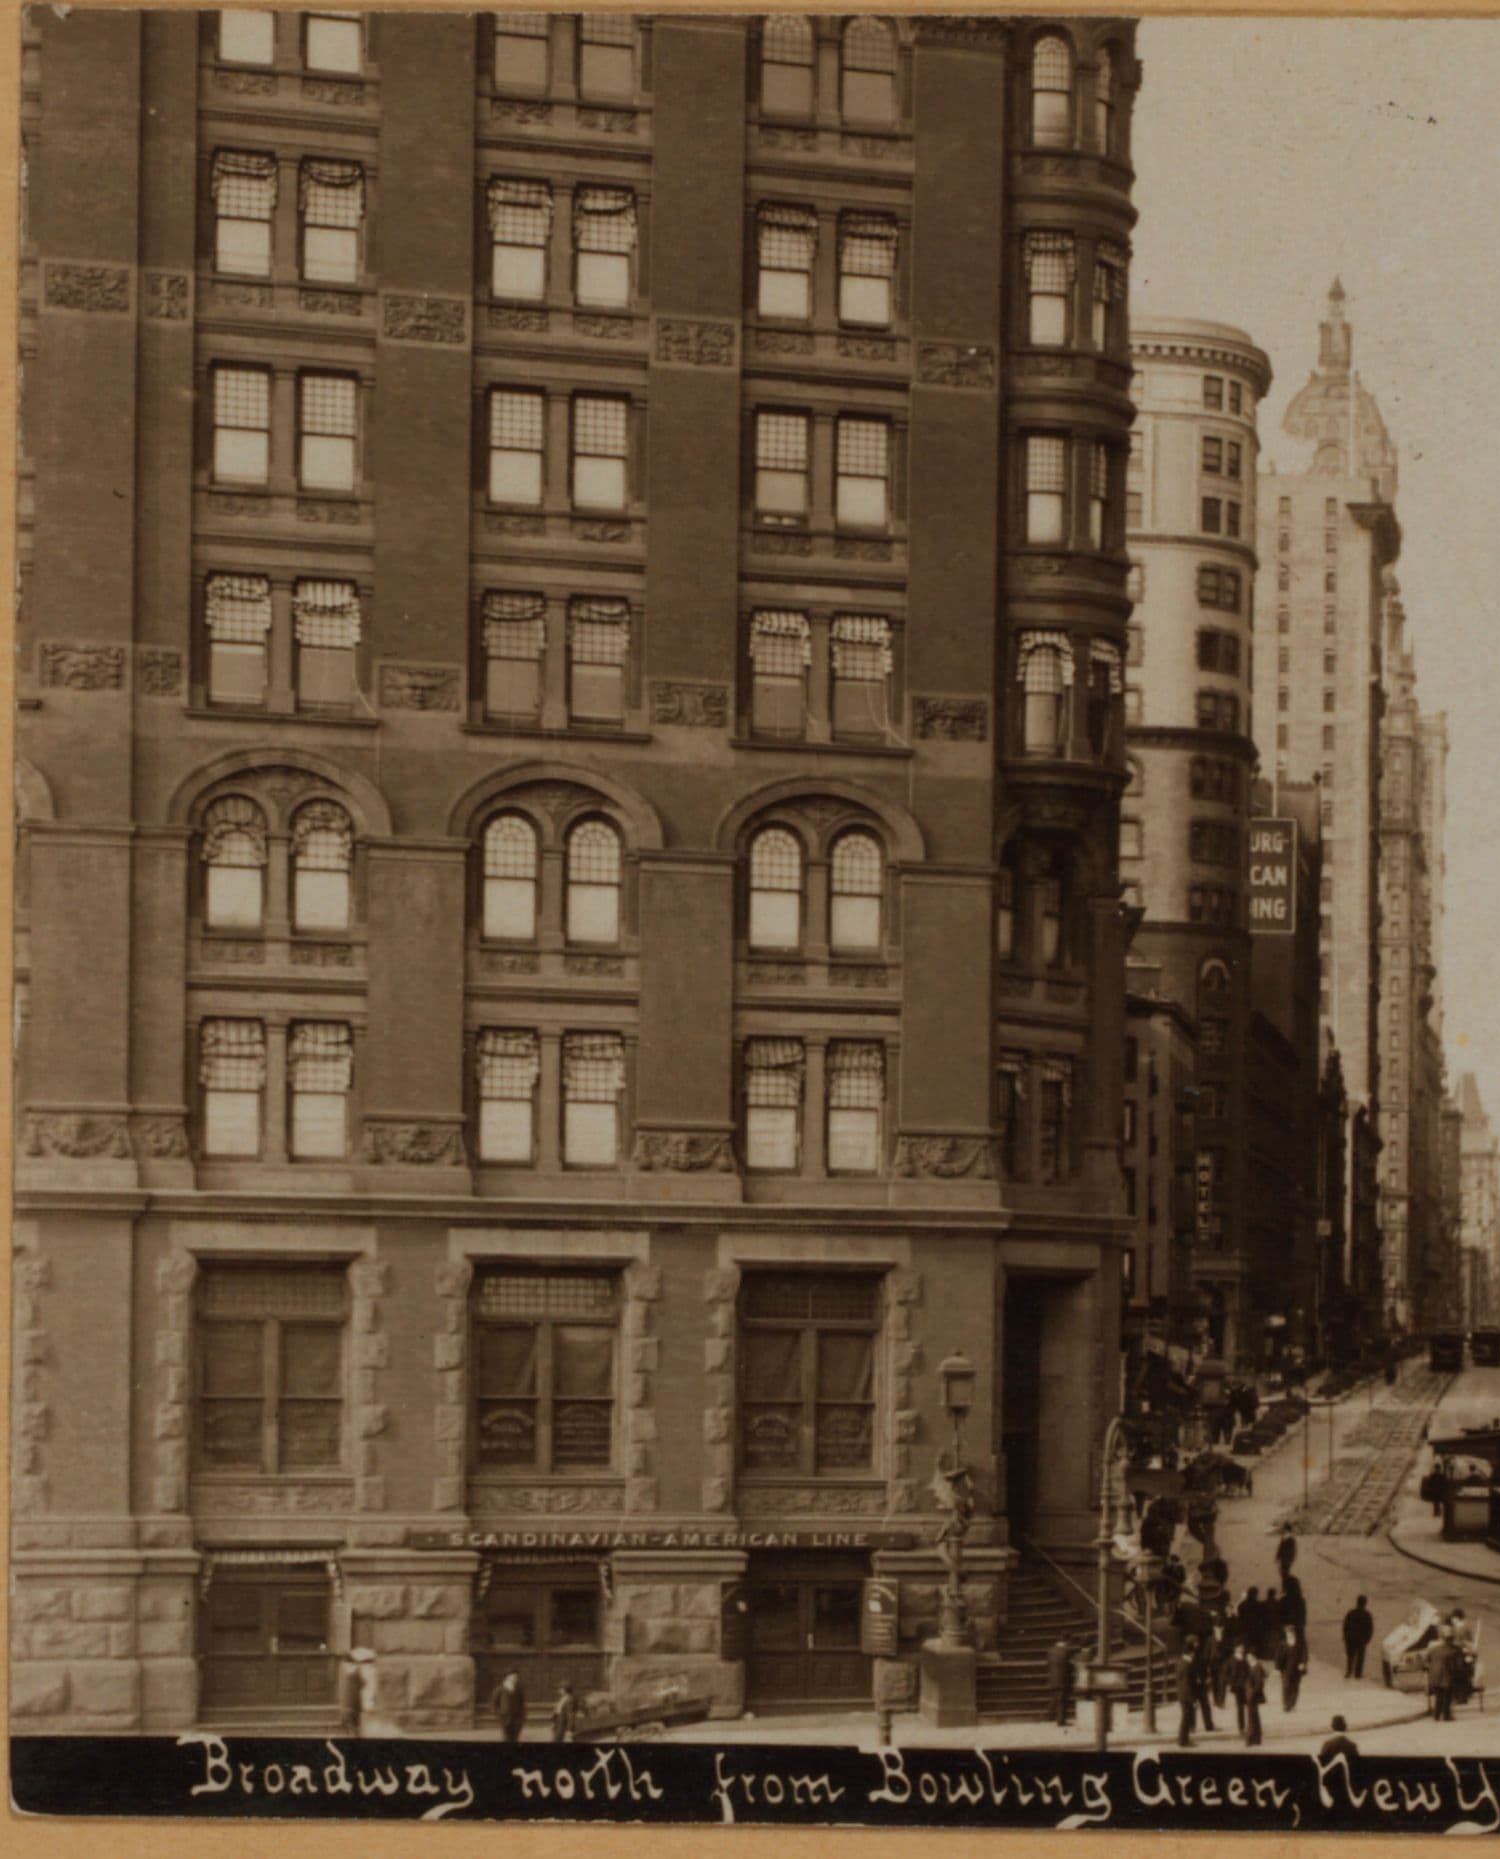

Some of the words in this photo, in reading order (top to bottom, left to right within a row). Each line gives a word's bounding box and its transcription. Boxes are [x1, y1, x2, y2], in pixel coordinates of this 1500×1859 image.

[1250, 865, 1288, 887] CAN
[1249, 897, 1287, 920] ING
[450, 1532, 798, 1547] SCANDINAVIAN-AMERICAN
[813, 1532, 868, 1547] LINE
